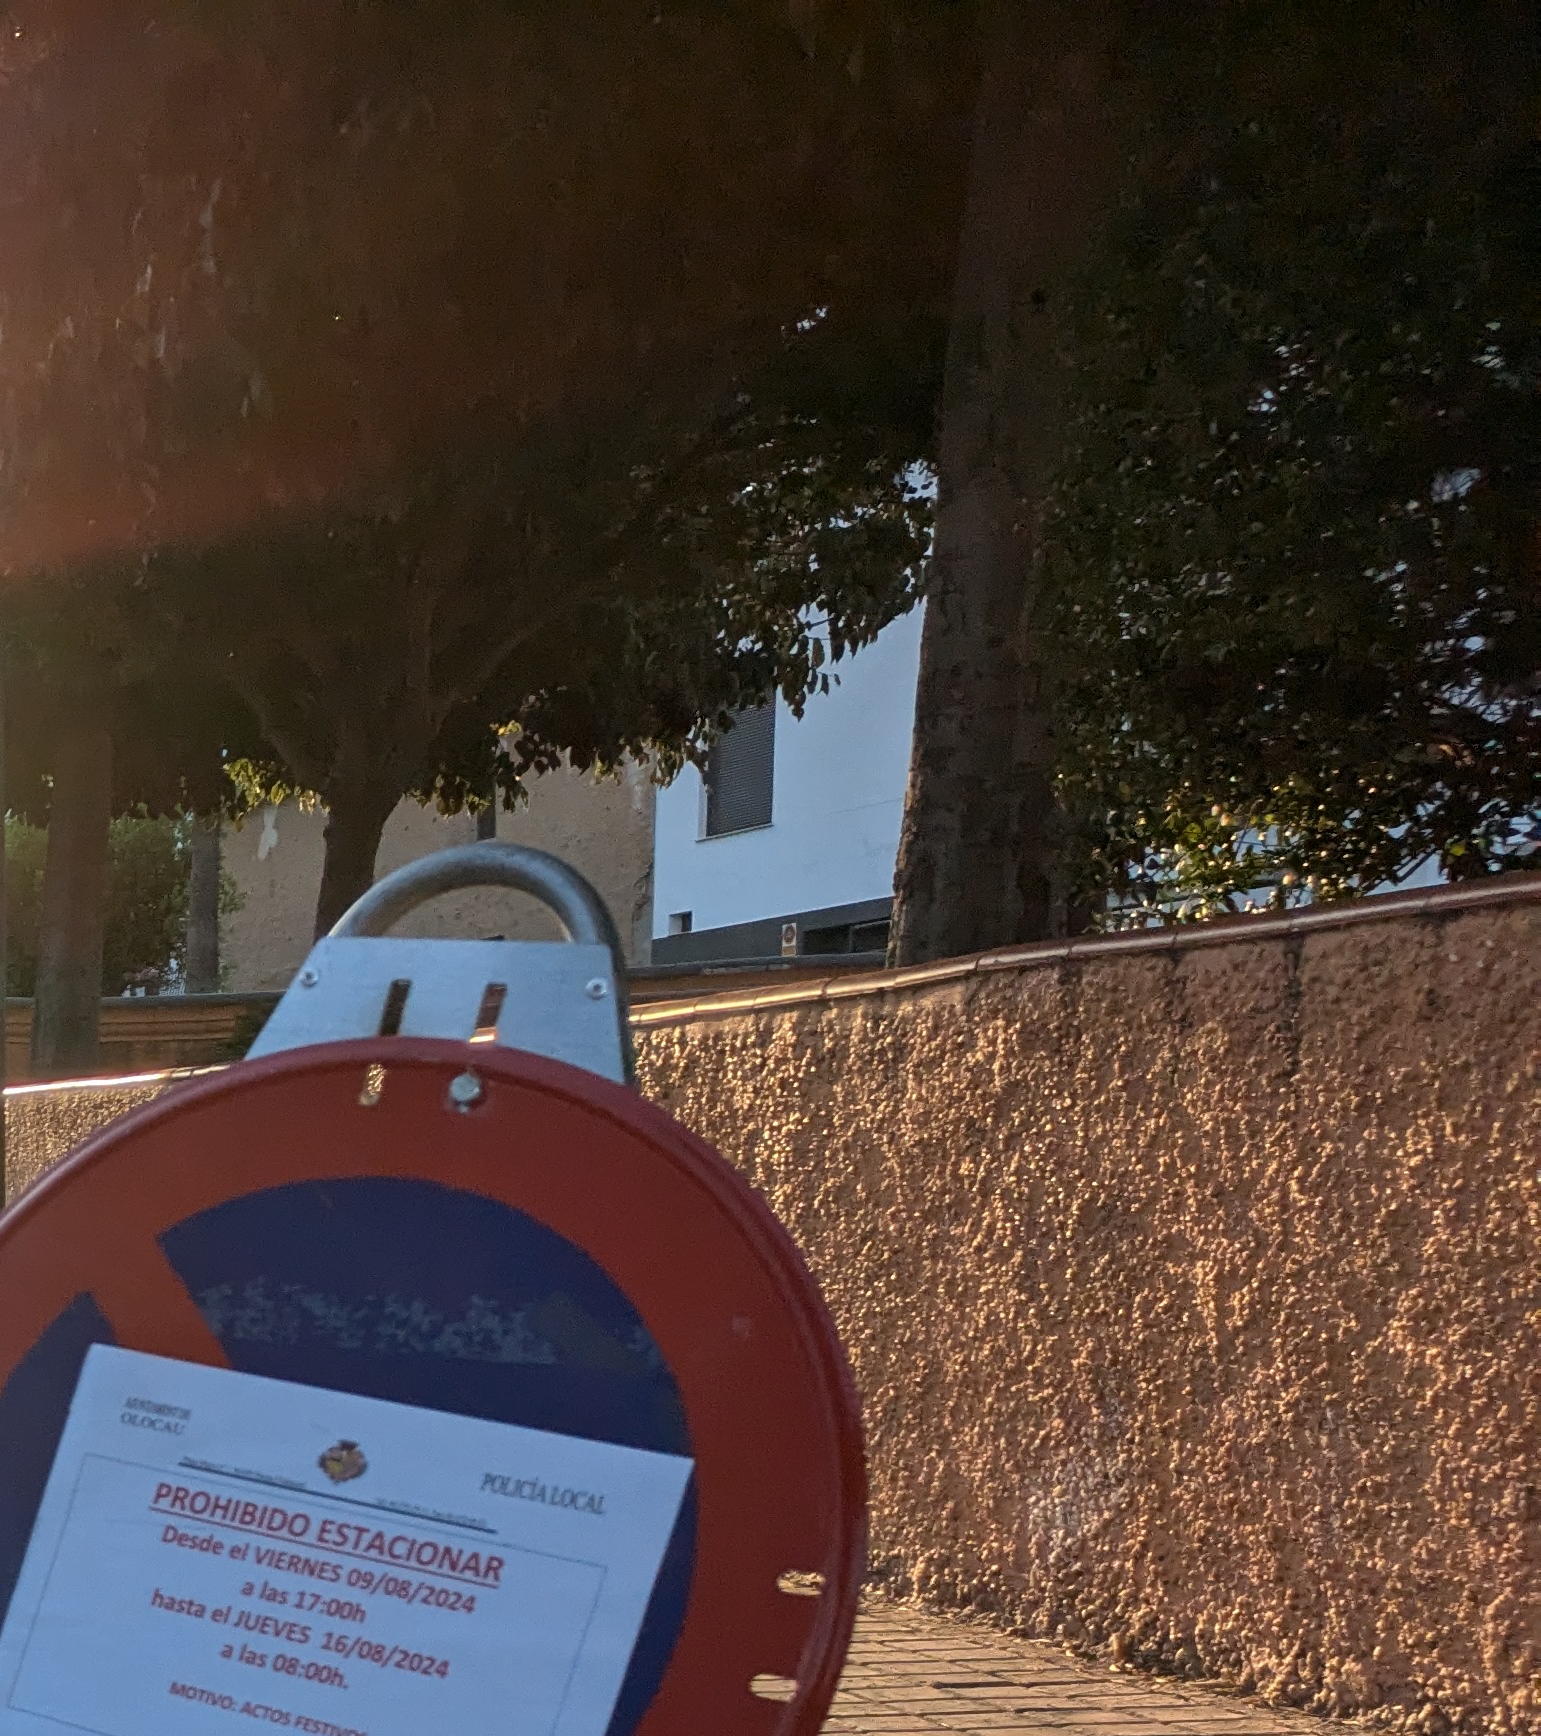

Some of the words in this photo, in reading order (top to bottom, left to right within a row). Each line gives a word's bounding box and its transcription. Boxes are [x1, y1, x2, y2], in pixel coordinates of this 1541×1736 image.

[551, 1486, 605, 1514] LOCAL
[152, 1481, 310, 1537] PROHIBIDO
[317, 1519, 505, 1582] ESTACIONAR
[161, 1525, 224, 1556] Desde
[229, 1541, 247, 1561] el
[254, 1548, 344, 1584] VIERNES
[346, 1568, 477, 1614] 09/08/2024
[240, 1581, 255, 1596] a
[259, 1580, 288, 1605] las
[293, 1591, 366, 1623] 17:00h
[151, 1588, 206, 1619] hasta
[210, 1605, 232, 1625] el
[233, 1610, 312, 1644] JUEVES
[320, 1631, 450, 1679] 16/08/2024
[220, 1644, 234, 1659] a
[238, 1643, 267, 1668] las
[272, 1653, 348, 1690] 08:00h.
[169, 1681, 236, 1711] MOTIVO:
[239, 1702, 291, 1725] ACTOS
